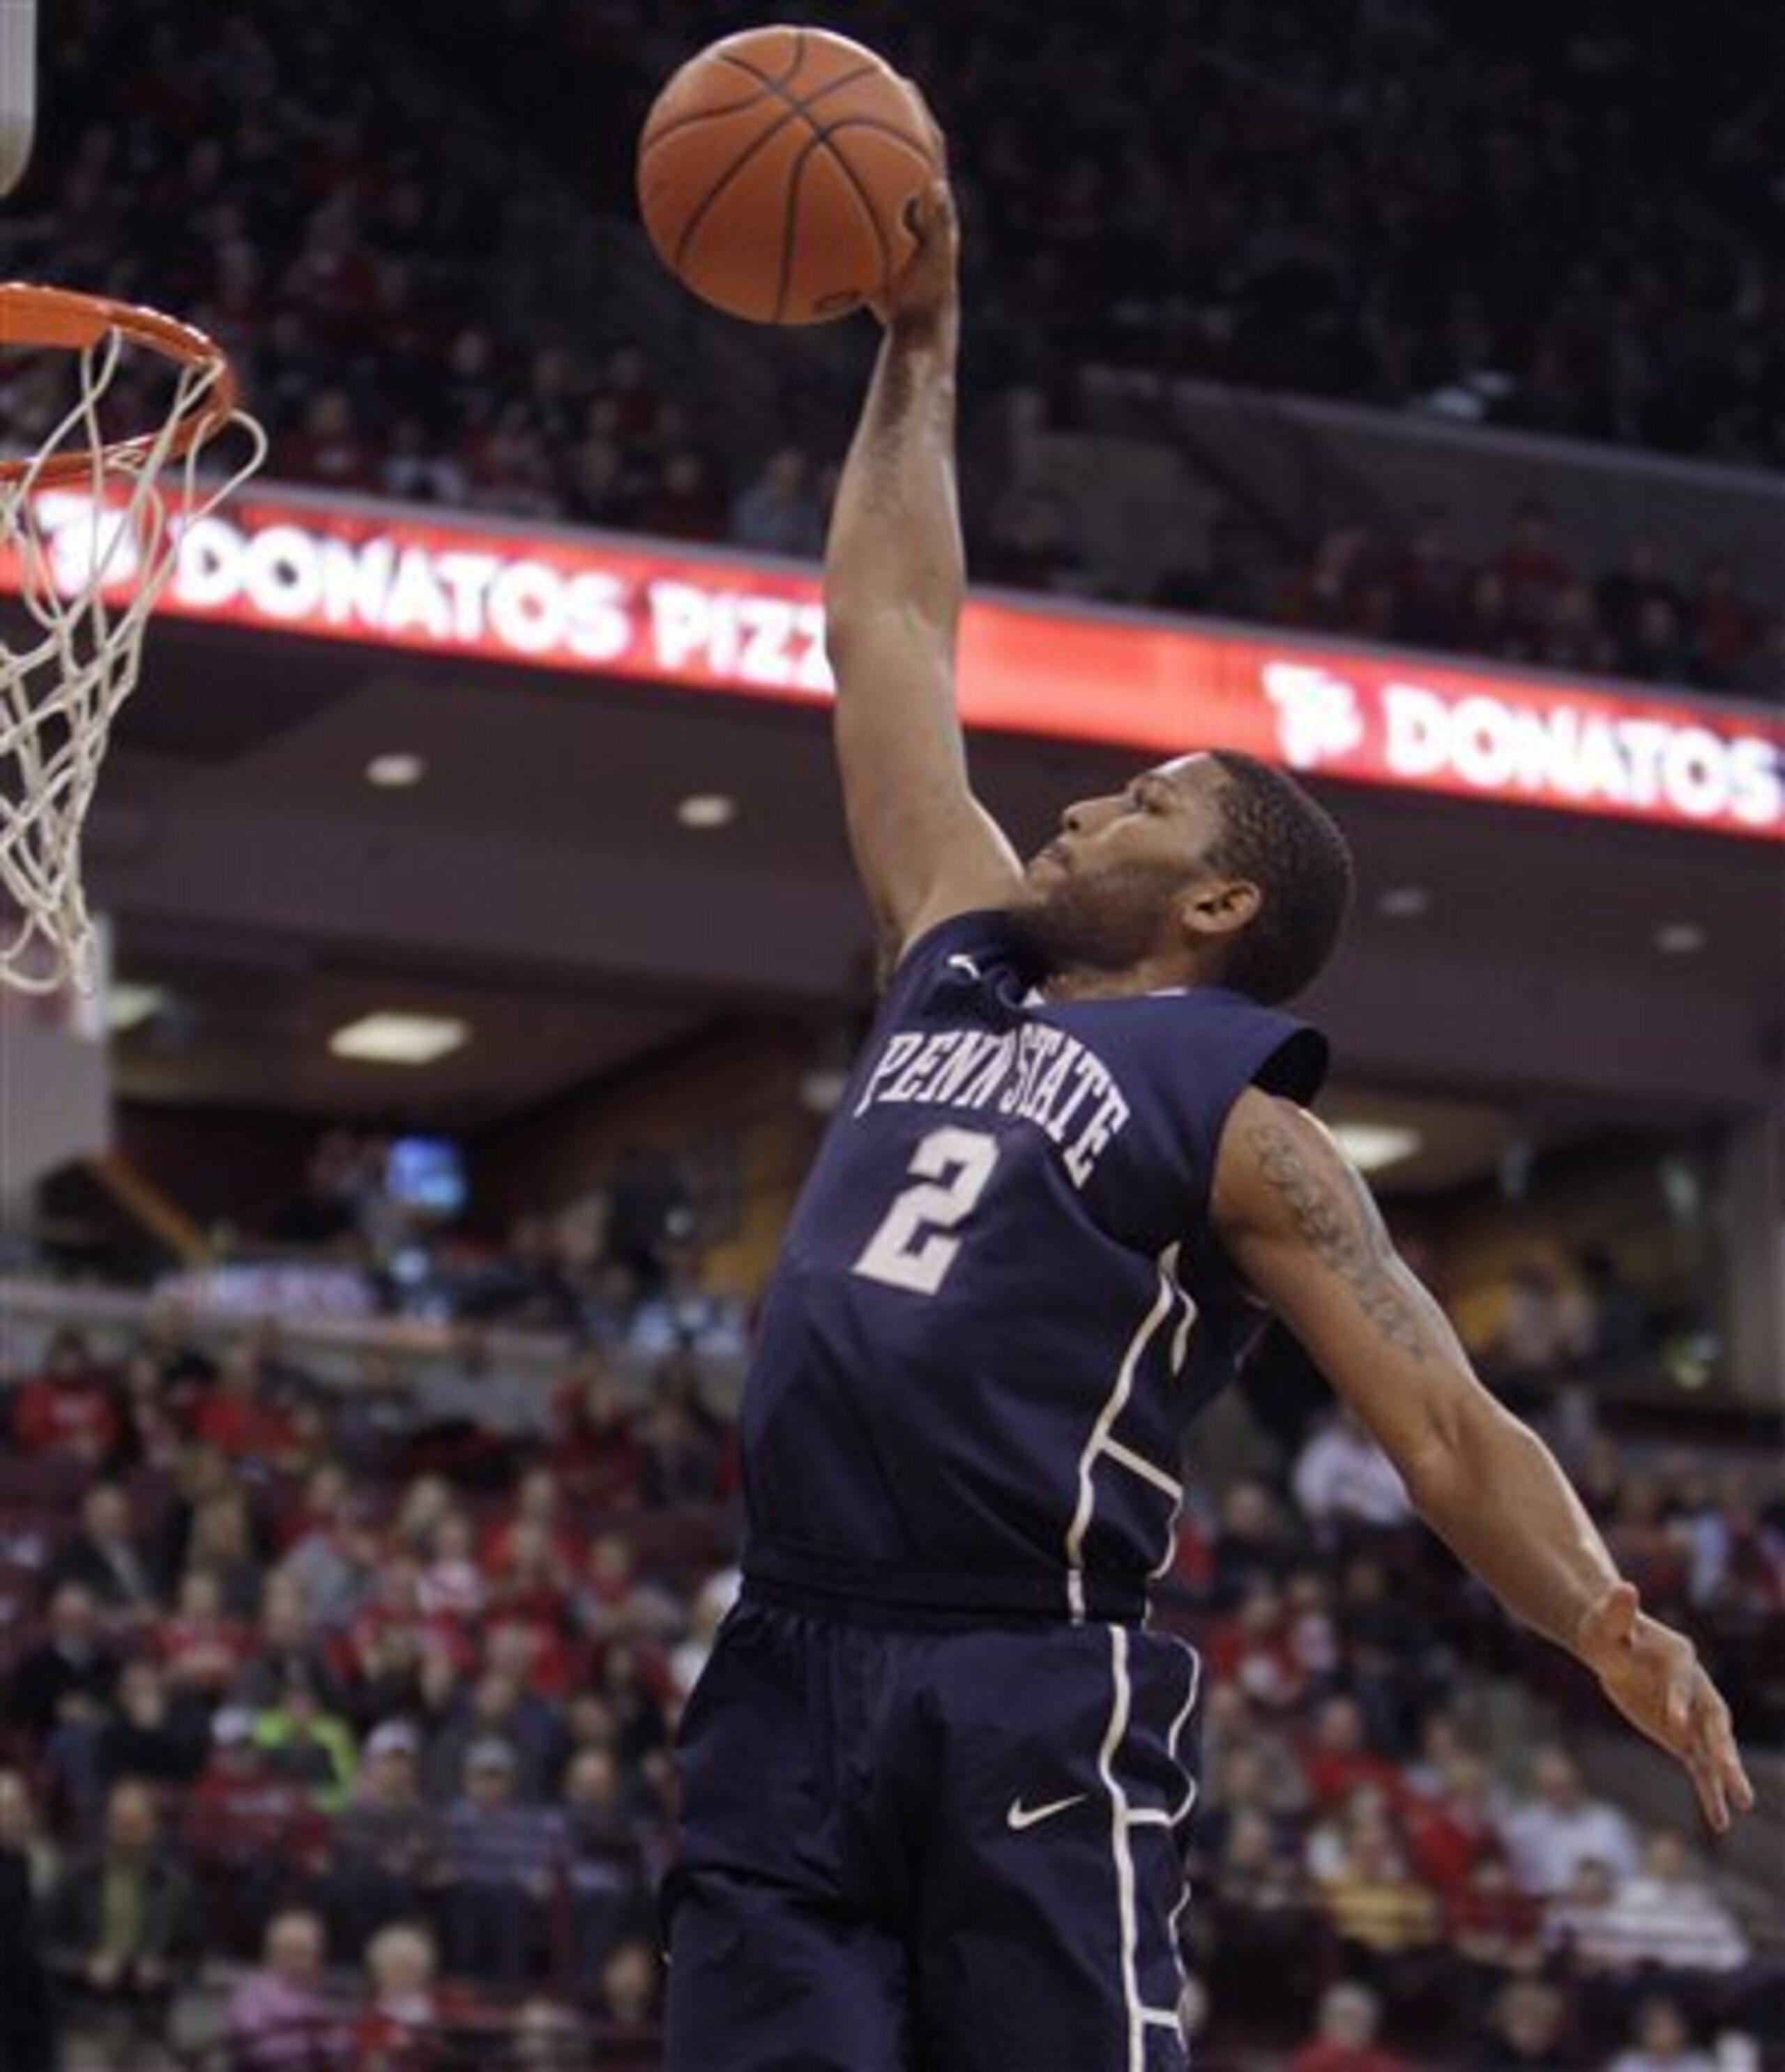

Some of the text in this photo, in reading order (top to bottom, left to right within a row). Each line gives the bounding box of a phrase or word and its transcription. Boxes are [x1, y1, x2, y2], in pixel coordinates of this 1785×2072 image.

[172, 516, 630, 661] DONATOS
[1381, 683, 1782, 825] DONATOS
[854, 1022, 1130, 1188] PENN STATE
[852, 1125, 999, 1295] 2
